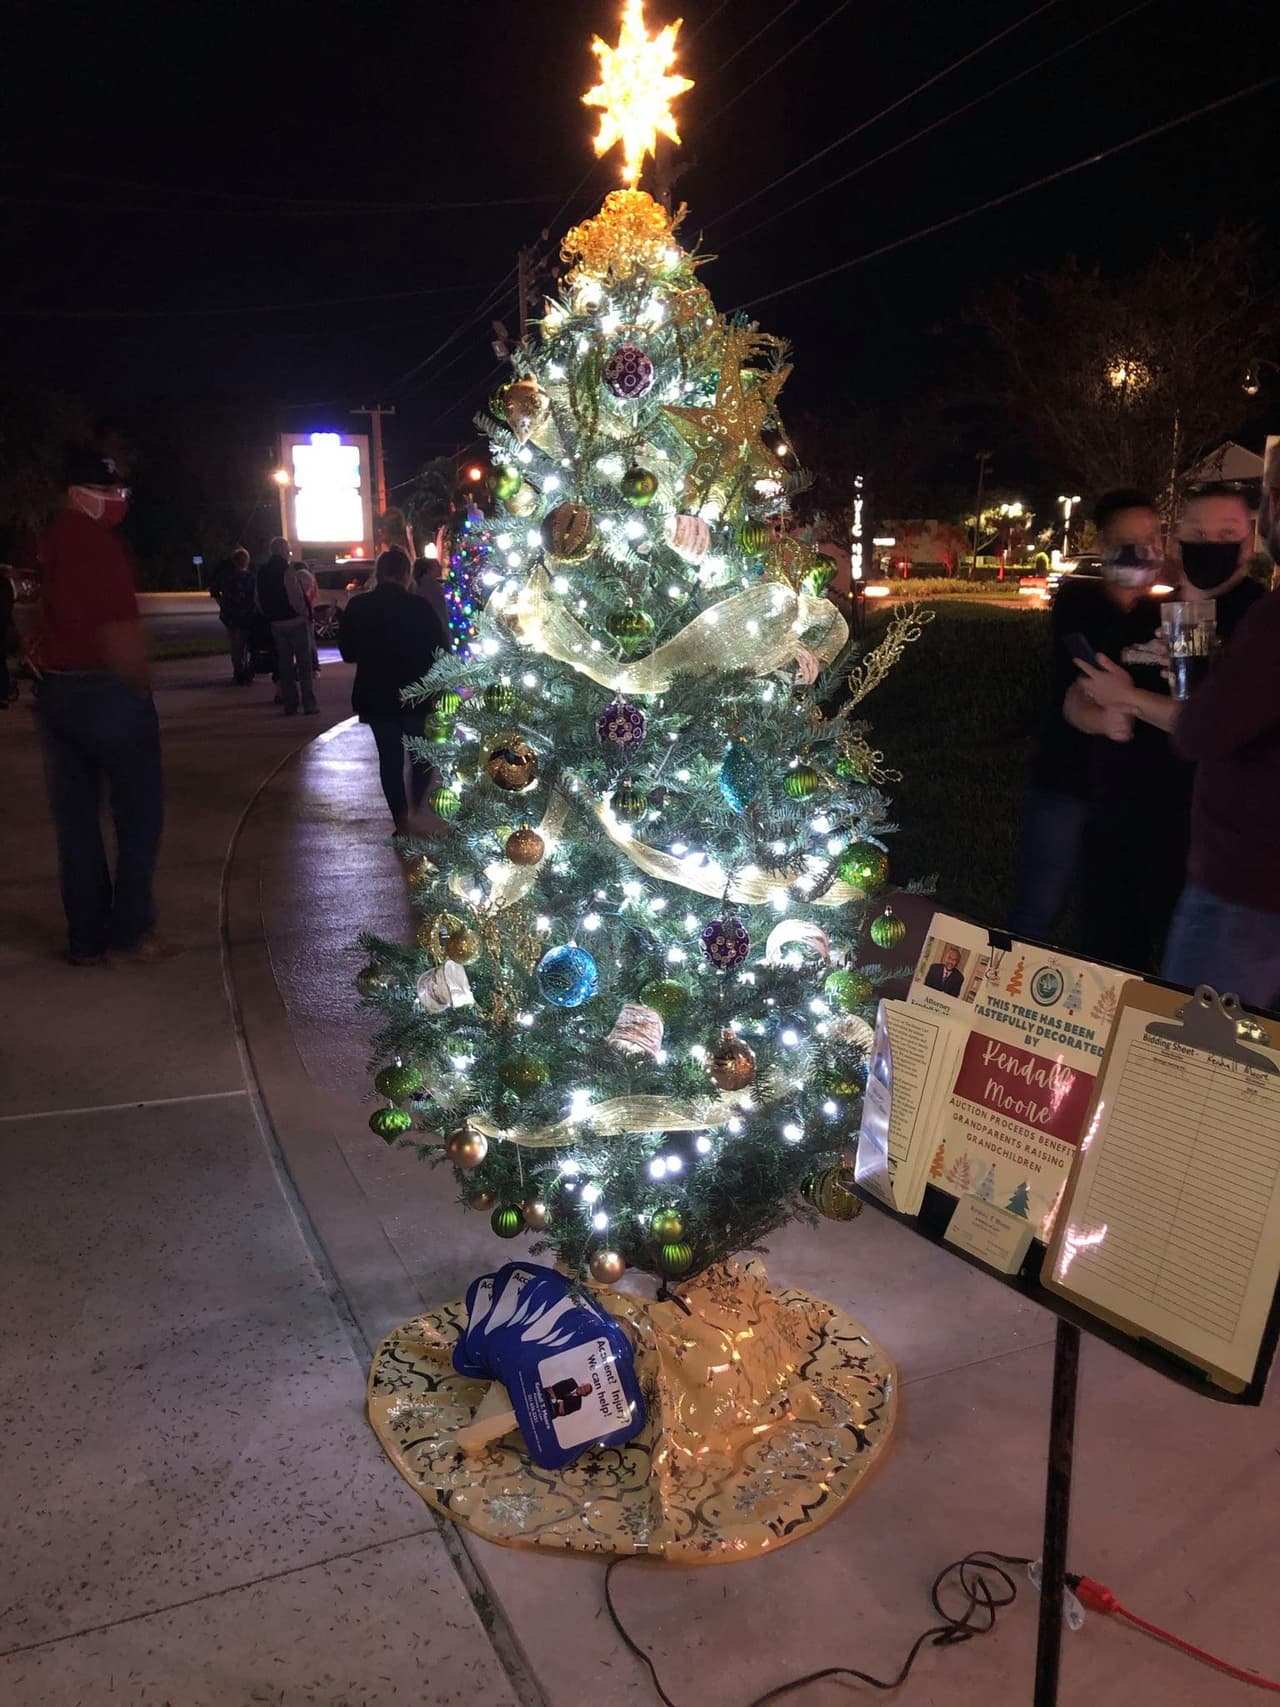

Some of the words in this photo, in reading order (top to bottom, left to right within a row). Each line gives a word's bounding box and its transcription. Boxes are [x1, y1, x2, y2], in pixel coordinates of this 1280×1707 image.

[974, 1004, 1035, 1033] TASTEFULLY
[1036, 1026, 1105, 1057] DECORATED
[987, 995, 1010, 1011] THIS
[1012, 1004, 1038, 1020] TREE
[1039, 1013, 1062, 1030] HAS
[1064, 1022, 1095, 1040] BEEN
[1024, 1035, 1040, 1047] BY
[1143, 1033, 1170, 1049] Bidding
[1172, 1042, 1195, 1057] Sheet
[982, 1040, 1073, 1092] Kendall
[984, 1077, 1051, 1124] Moore
[950, 1098, 987, 1119] AUCTION
[990, 1114, 1036, 1140] PROCEEDS
[1038, 1135, 1076, 1158] BENEFIT
[952, 1112, 1022, 1148] GRANDPARENTS
[1024, 1144, 1065, 1168] RAISING
[966, 1133, 1042, 1173] GRANDCHILDREN
[592, 1372, 602, 1390] can
[597, 1391, 612, 1418] help!
[612, 1390, 630, 1424] Injury?
